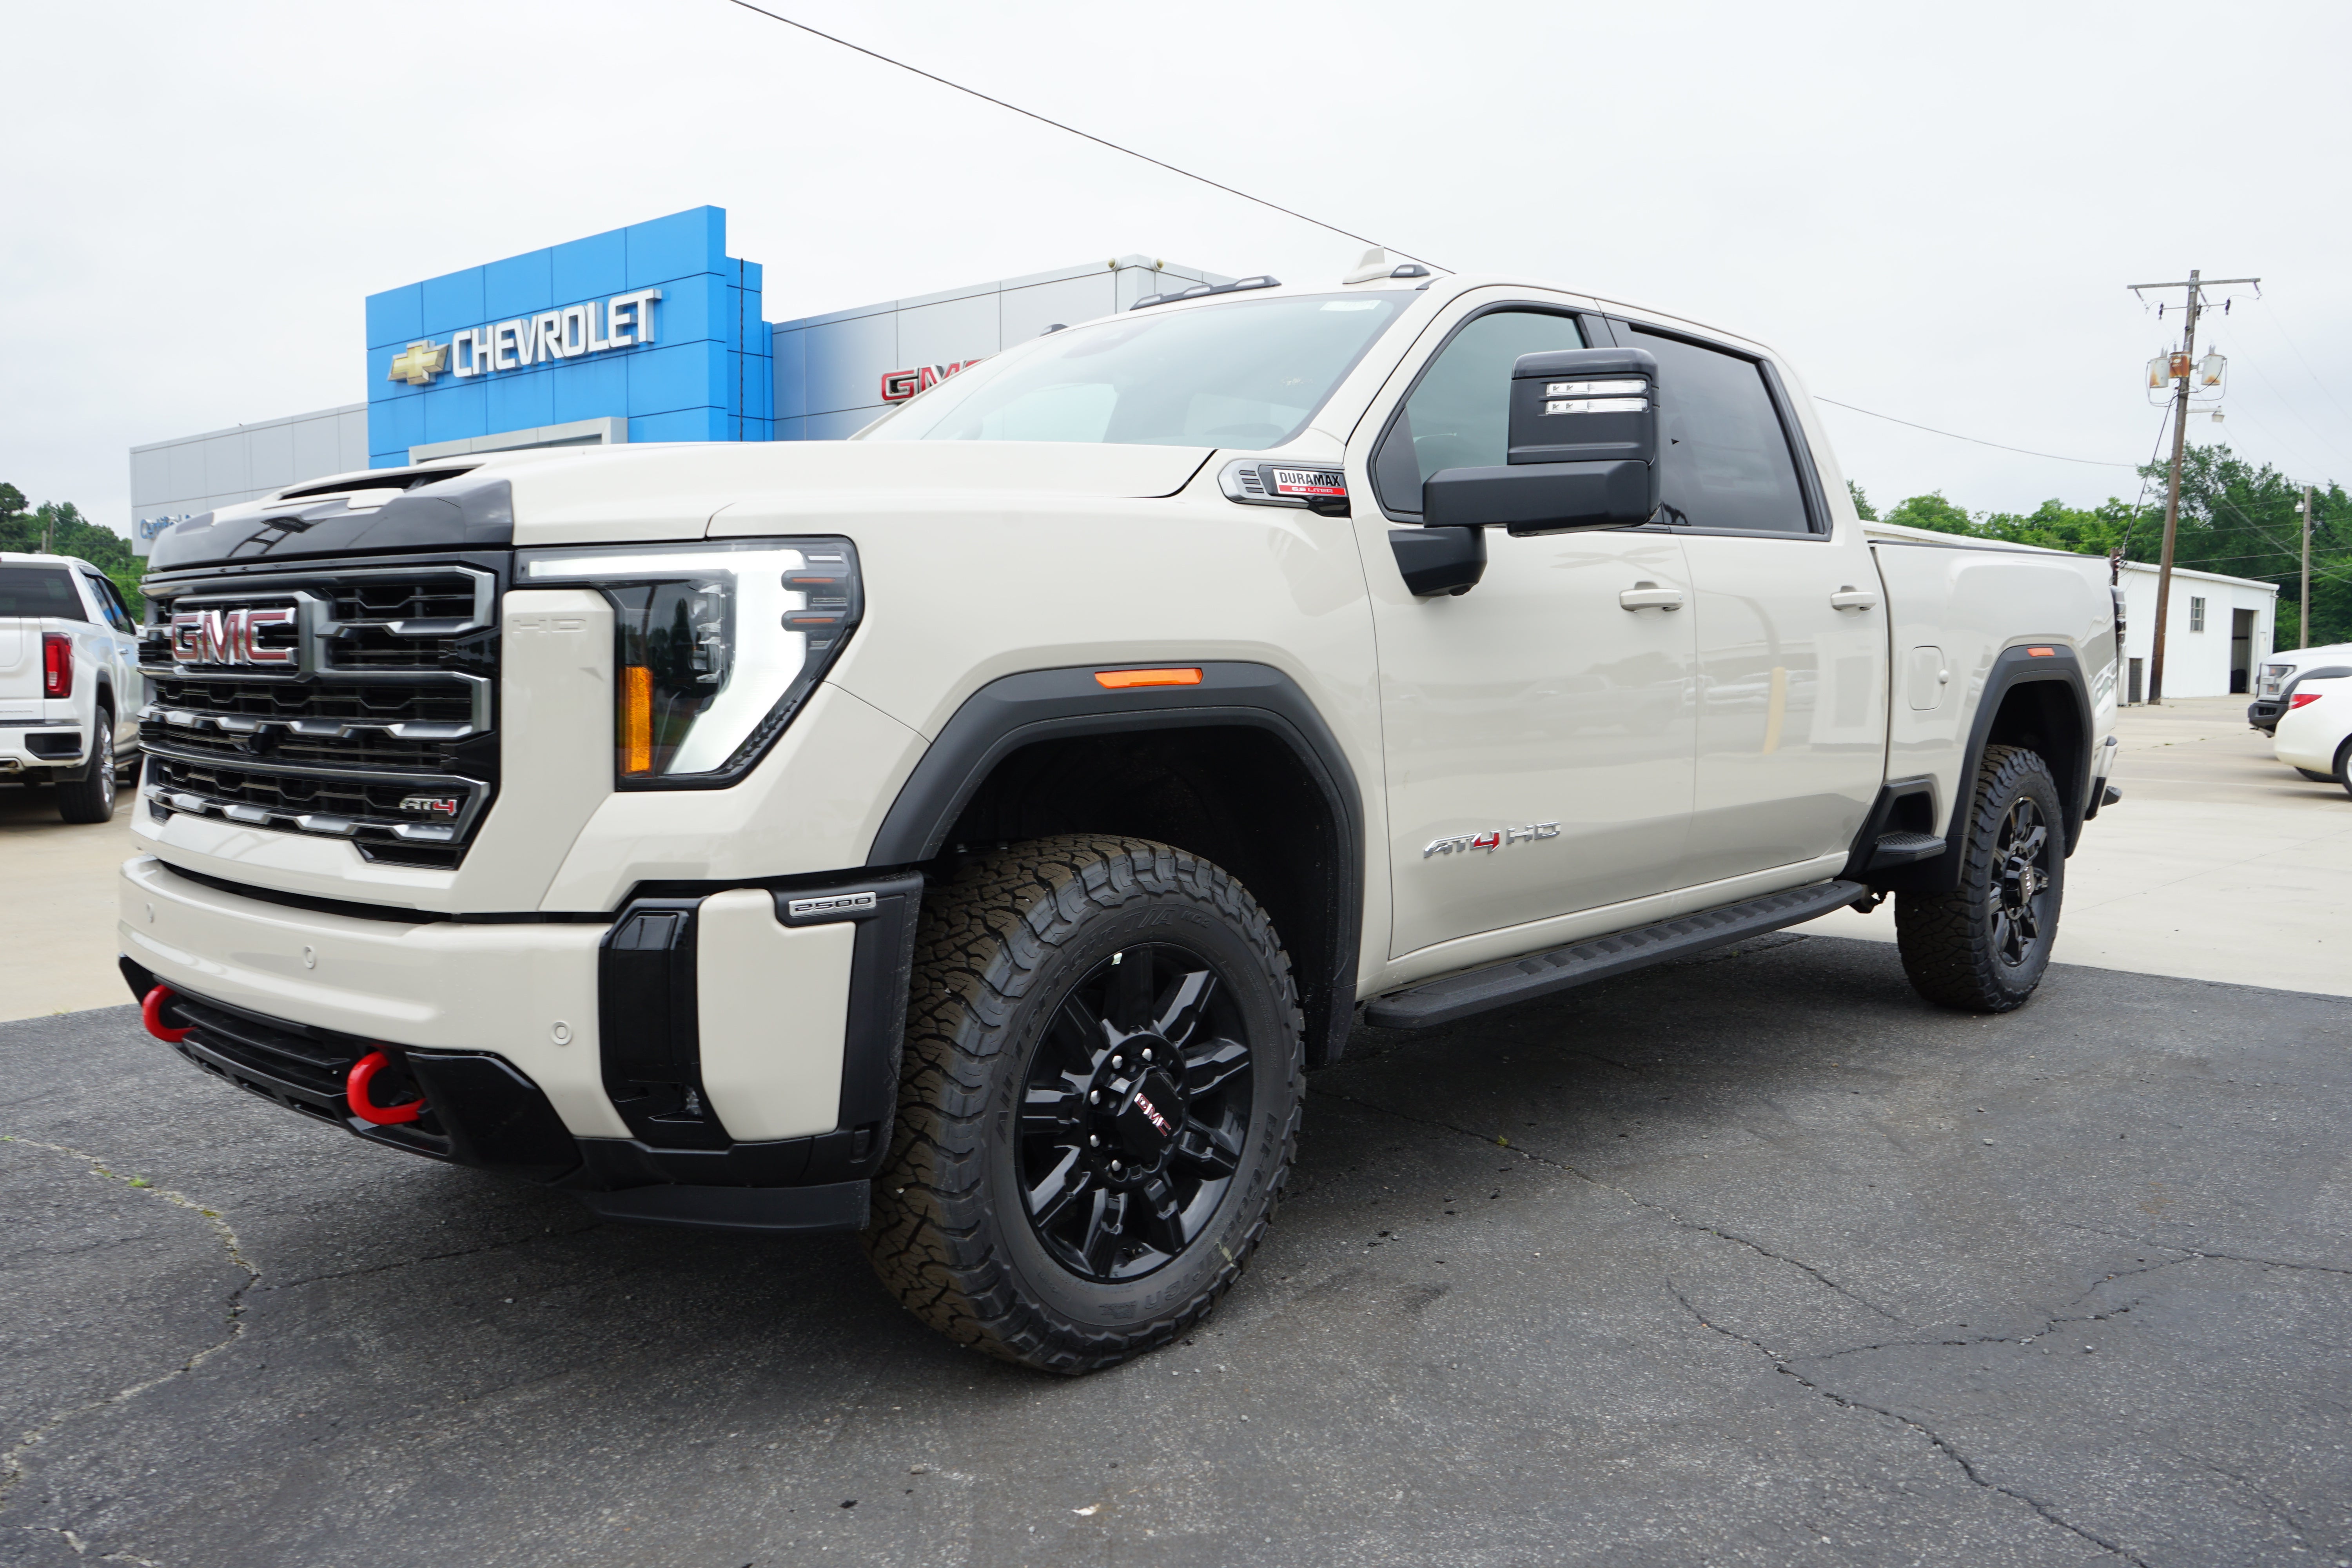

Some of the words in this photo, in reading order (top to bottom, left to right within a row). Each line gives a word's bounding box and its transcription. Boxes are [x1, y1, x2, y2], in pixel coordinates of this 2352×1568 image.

[452, 289, 662, 378] CHEVROLET
[880, 357, 985, 405] GM
[1279, 472, 1341, 486] DURAMAX
[171, 607, 299, 666] GMC
[512, 619, 586, 633] HD
[399, 798, 458, 816] AT4
[1423, 829, 1501, 858] AT4
[1506, 821, 1561, 844] HD
[794, 897, 871, 912] 2500
[1123, 908, 1176, 933] T/A
[1134, 1093, 1172, 1137] GMC
